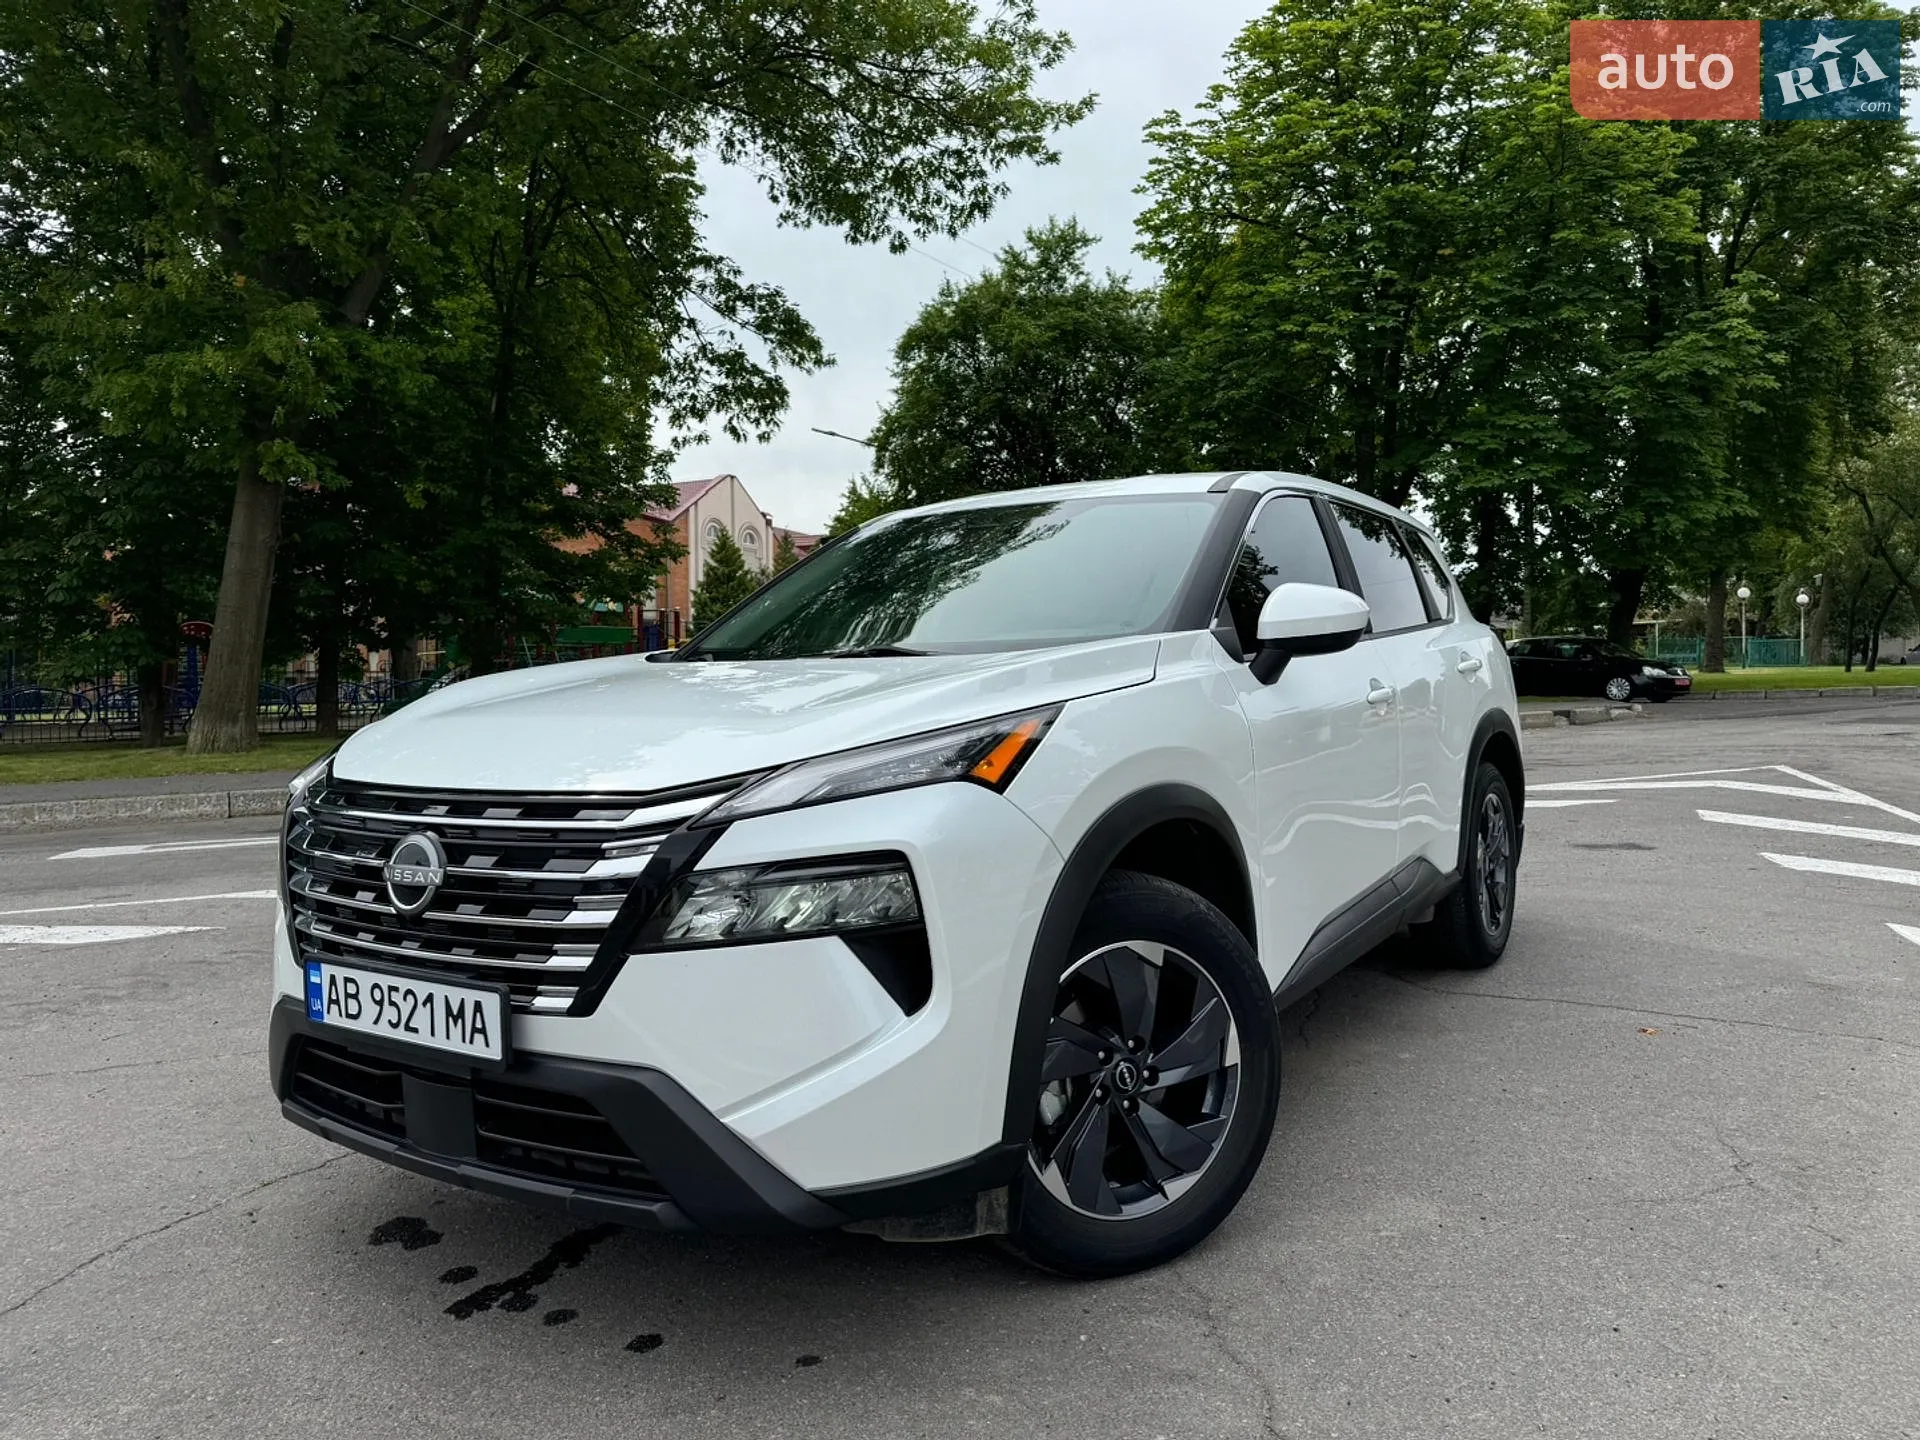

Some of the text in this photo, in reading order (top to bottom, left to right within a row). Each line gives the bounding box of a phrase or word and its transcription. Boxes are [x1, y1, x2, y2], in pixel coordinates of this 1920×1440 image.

[311, 998, 323, 1012] UA
[327, 974, 490, 1048] AB 9521 MA
